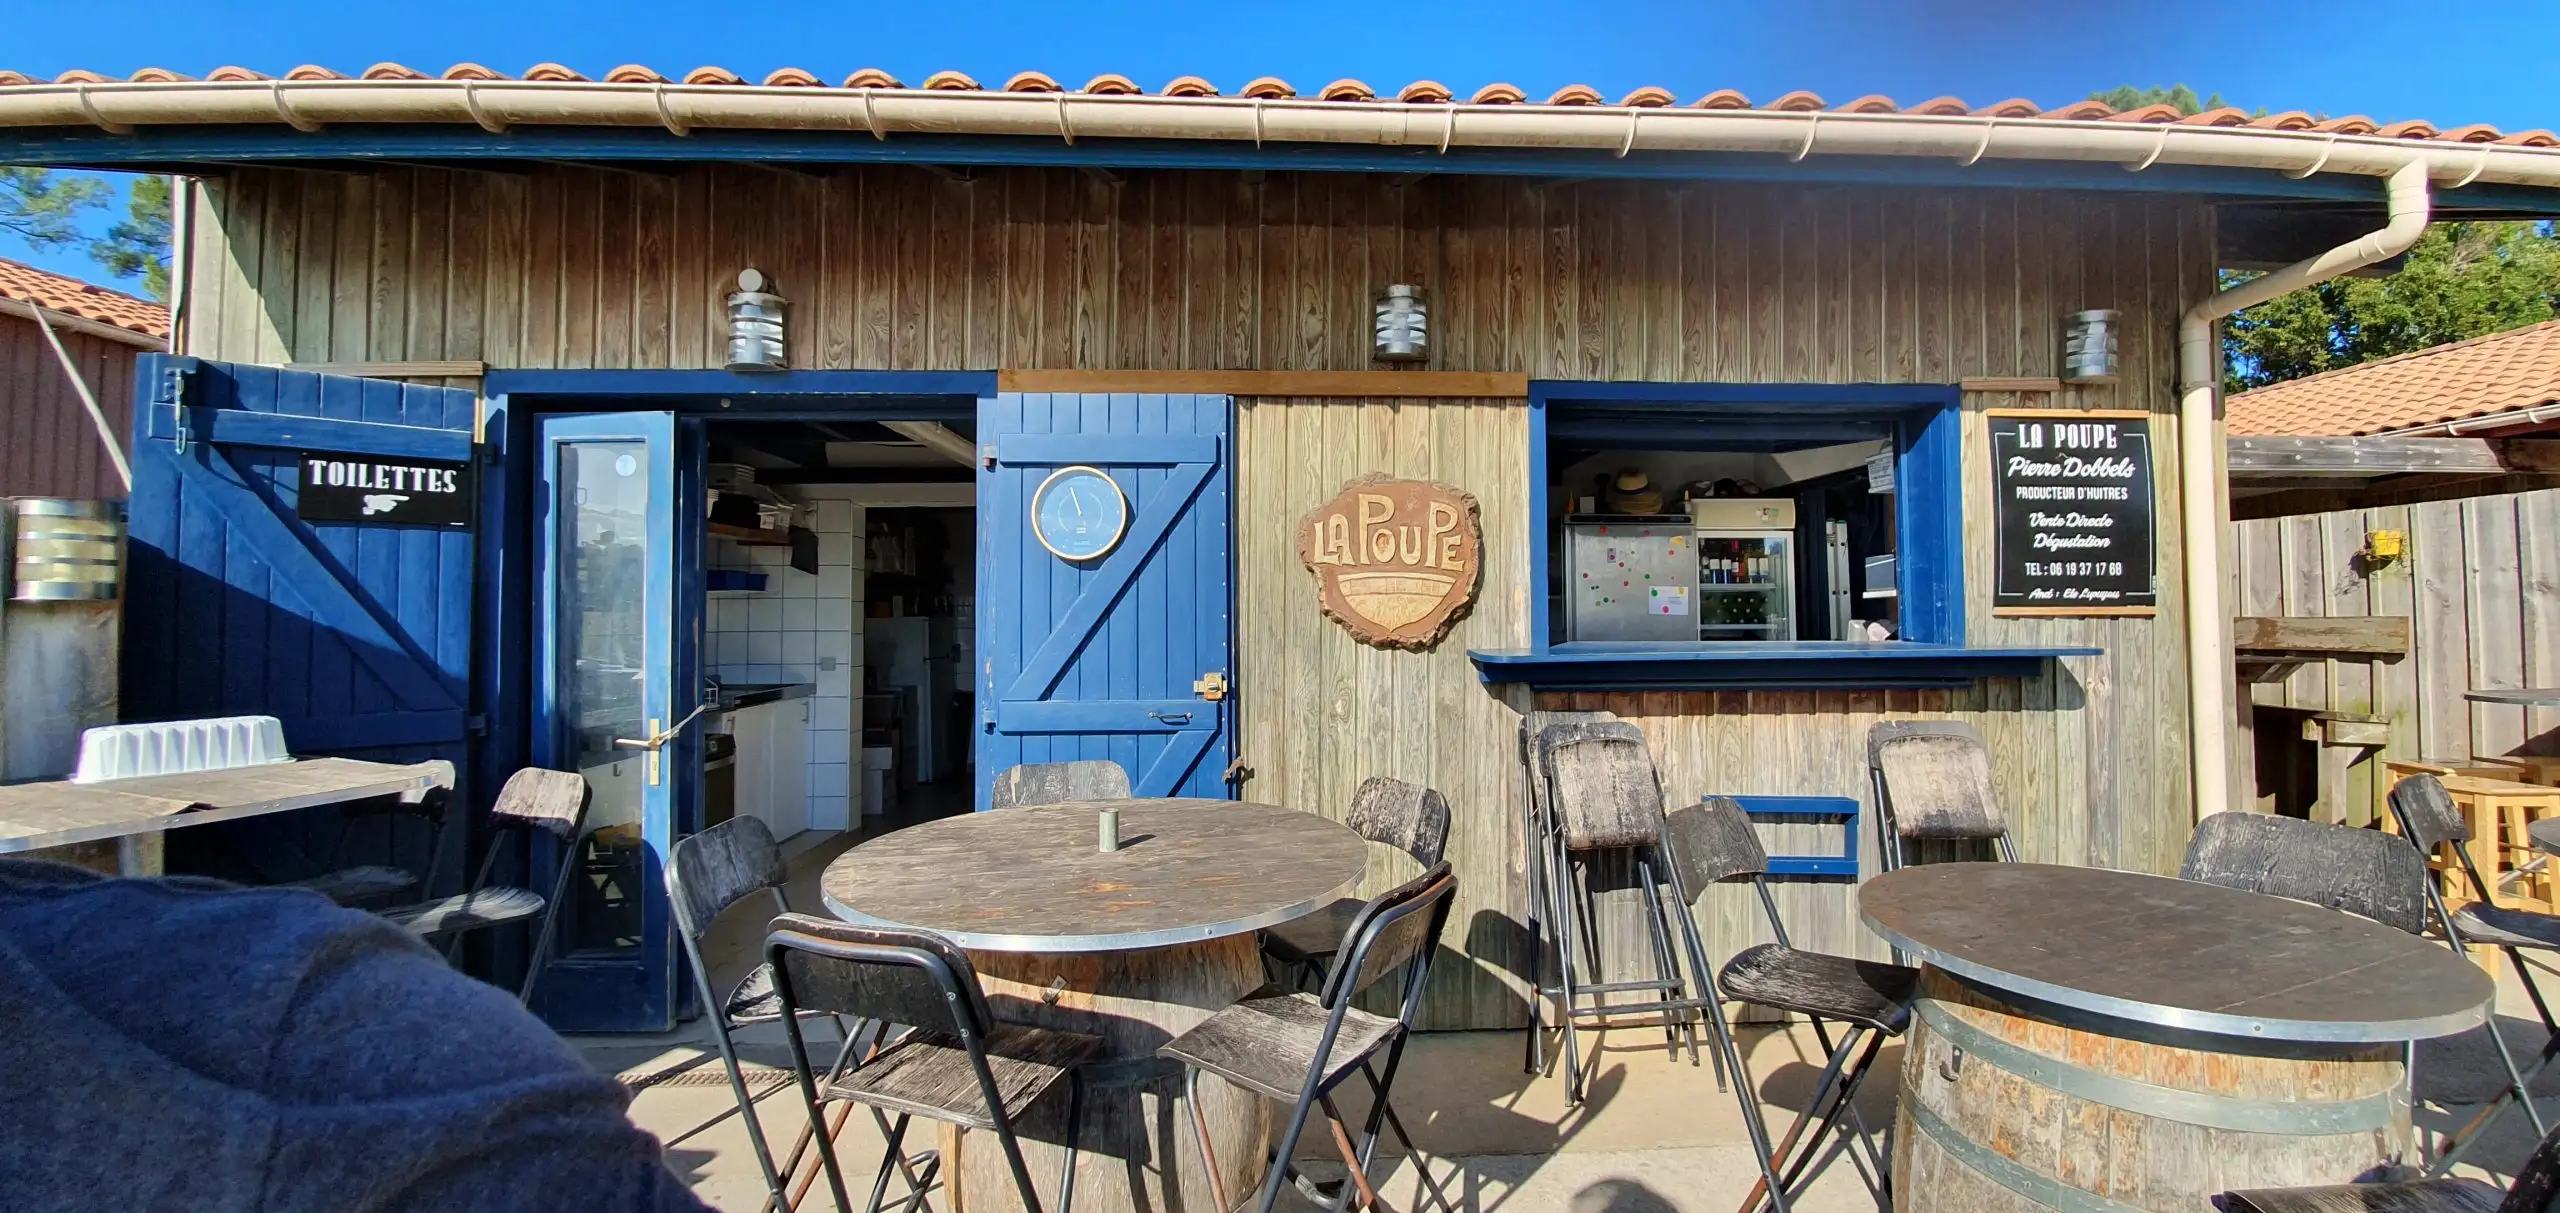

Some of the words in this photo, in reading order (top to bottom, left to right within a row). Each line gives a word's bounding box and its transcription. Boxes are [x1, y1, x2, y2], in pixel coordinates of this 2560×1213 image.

[2018, 423, 2043, 449] LA
[2054, 424, 2118, 449] POUPE
[308, 460, 457, 493] TOILETTES
[2007, 455, 2062, 478] Pierre
[2062, 456, 2136, 478] Dobbels
[2016, 486, 2075, 500] PRODUCTEUR
[2077, 487, 2128, 500] D'HUITRES
[2029, 512, 2065, 527] Vente
[2066, 512, 2113, 527] Directe
[1314, 514, 1356, 566] LA
[2033, 533, 2110, 552] Dégustation
[2050, 562, 2062, 576] 06
[2065, 562, 2076, 576] 19
[2079, 562, 2091, 576] 37
[2095, 562, 2106, 576] 17
[2109, 562, 2122, 576] 68
